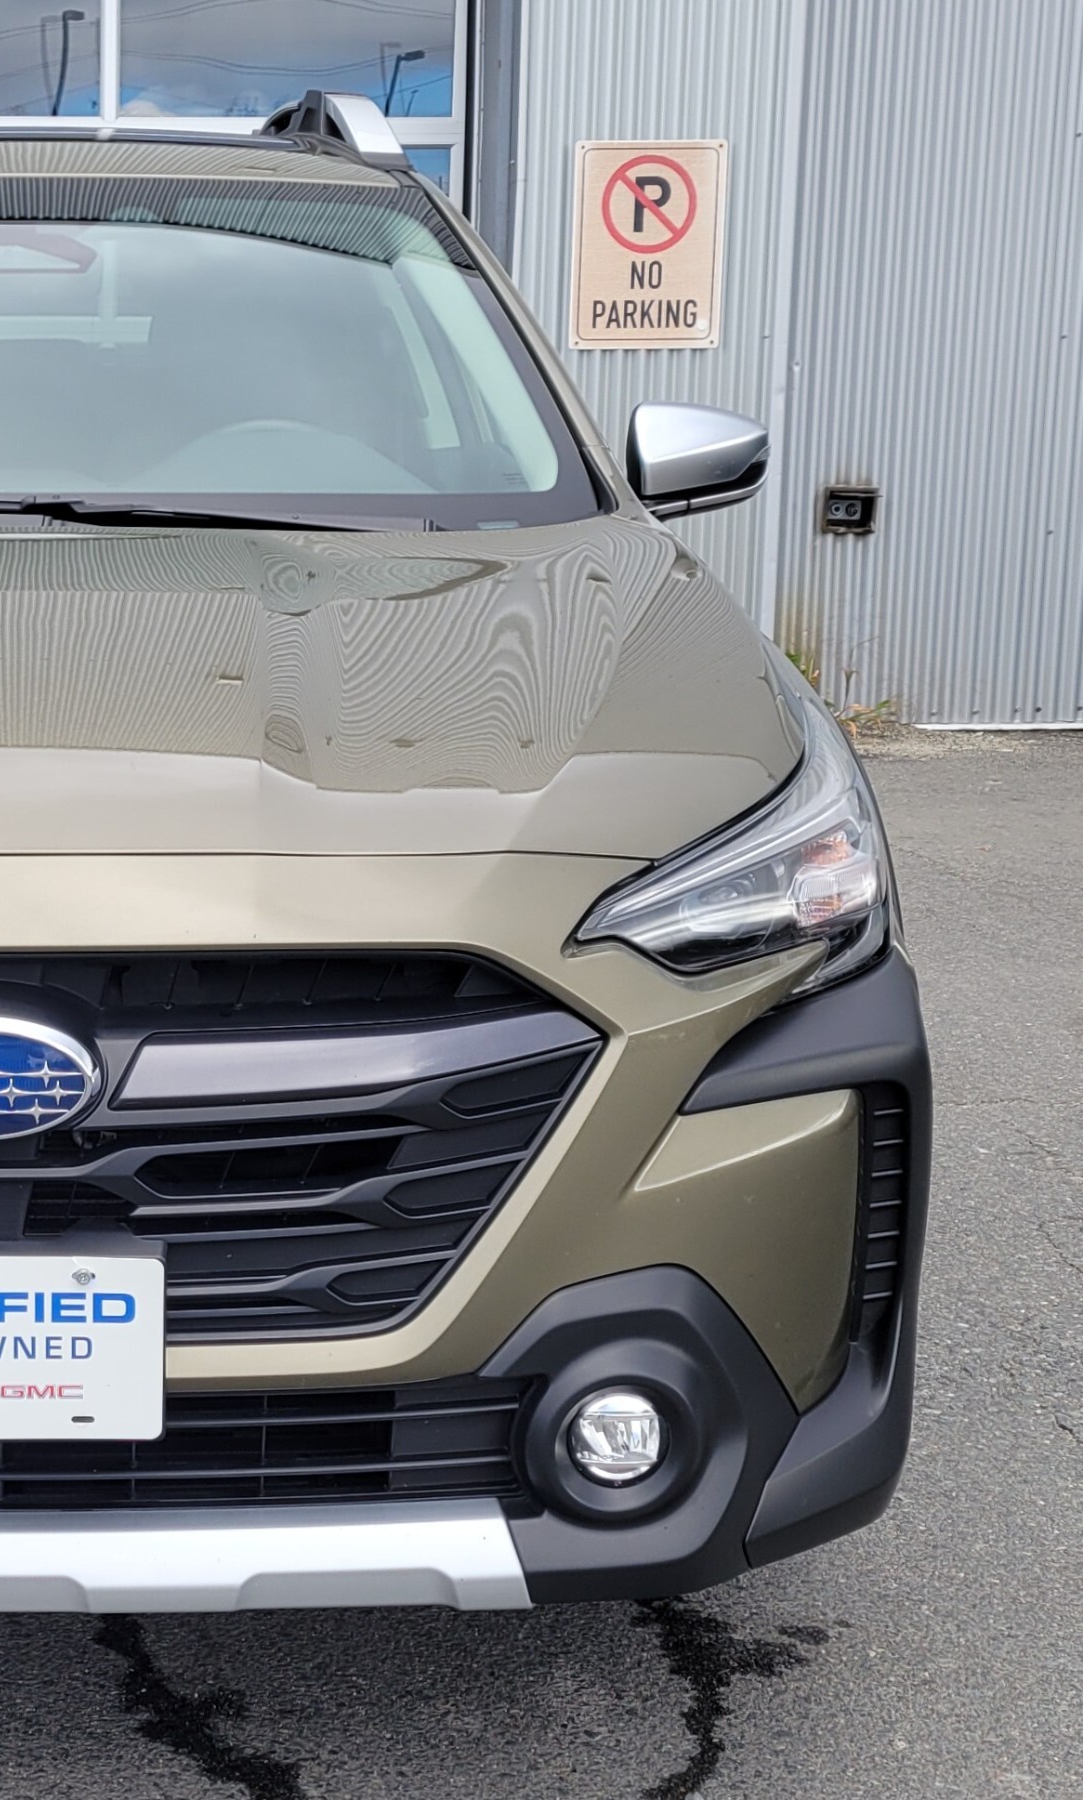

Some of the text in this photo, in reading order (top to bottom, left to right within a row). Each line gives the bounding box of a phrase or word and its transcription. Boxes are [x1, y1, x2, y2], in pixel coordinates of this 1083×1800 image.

[629, 260, 663, 290] NO
[591, 299, 698, 329] PARKING
[0, 1384, 85, 1400] GMC
